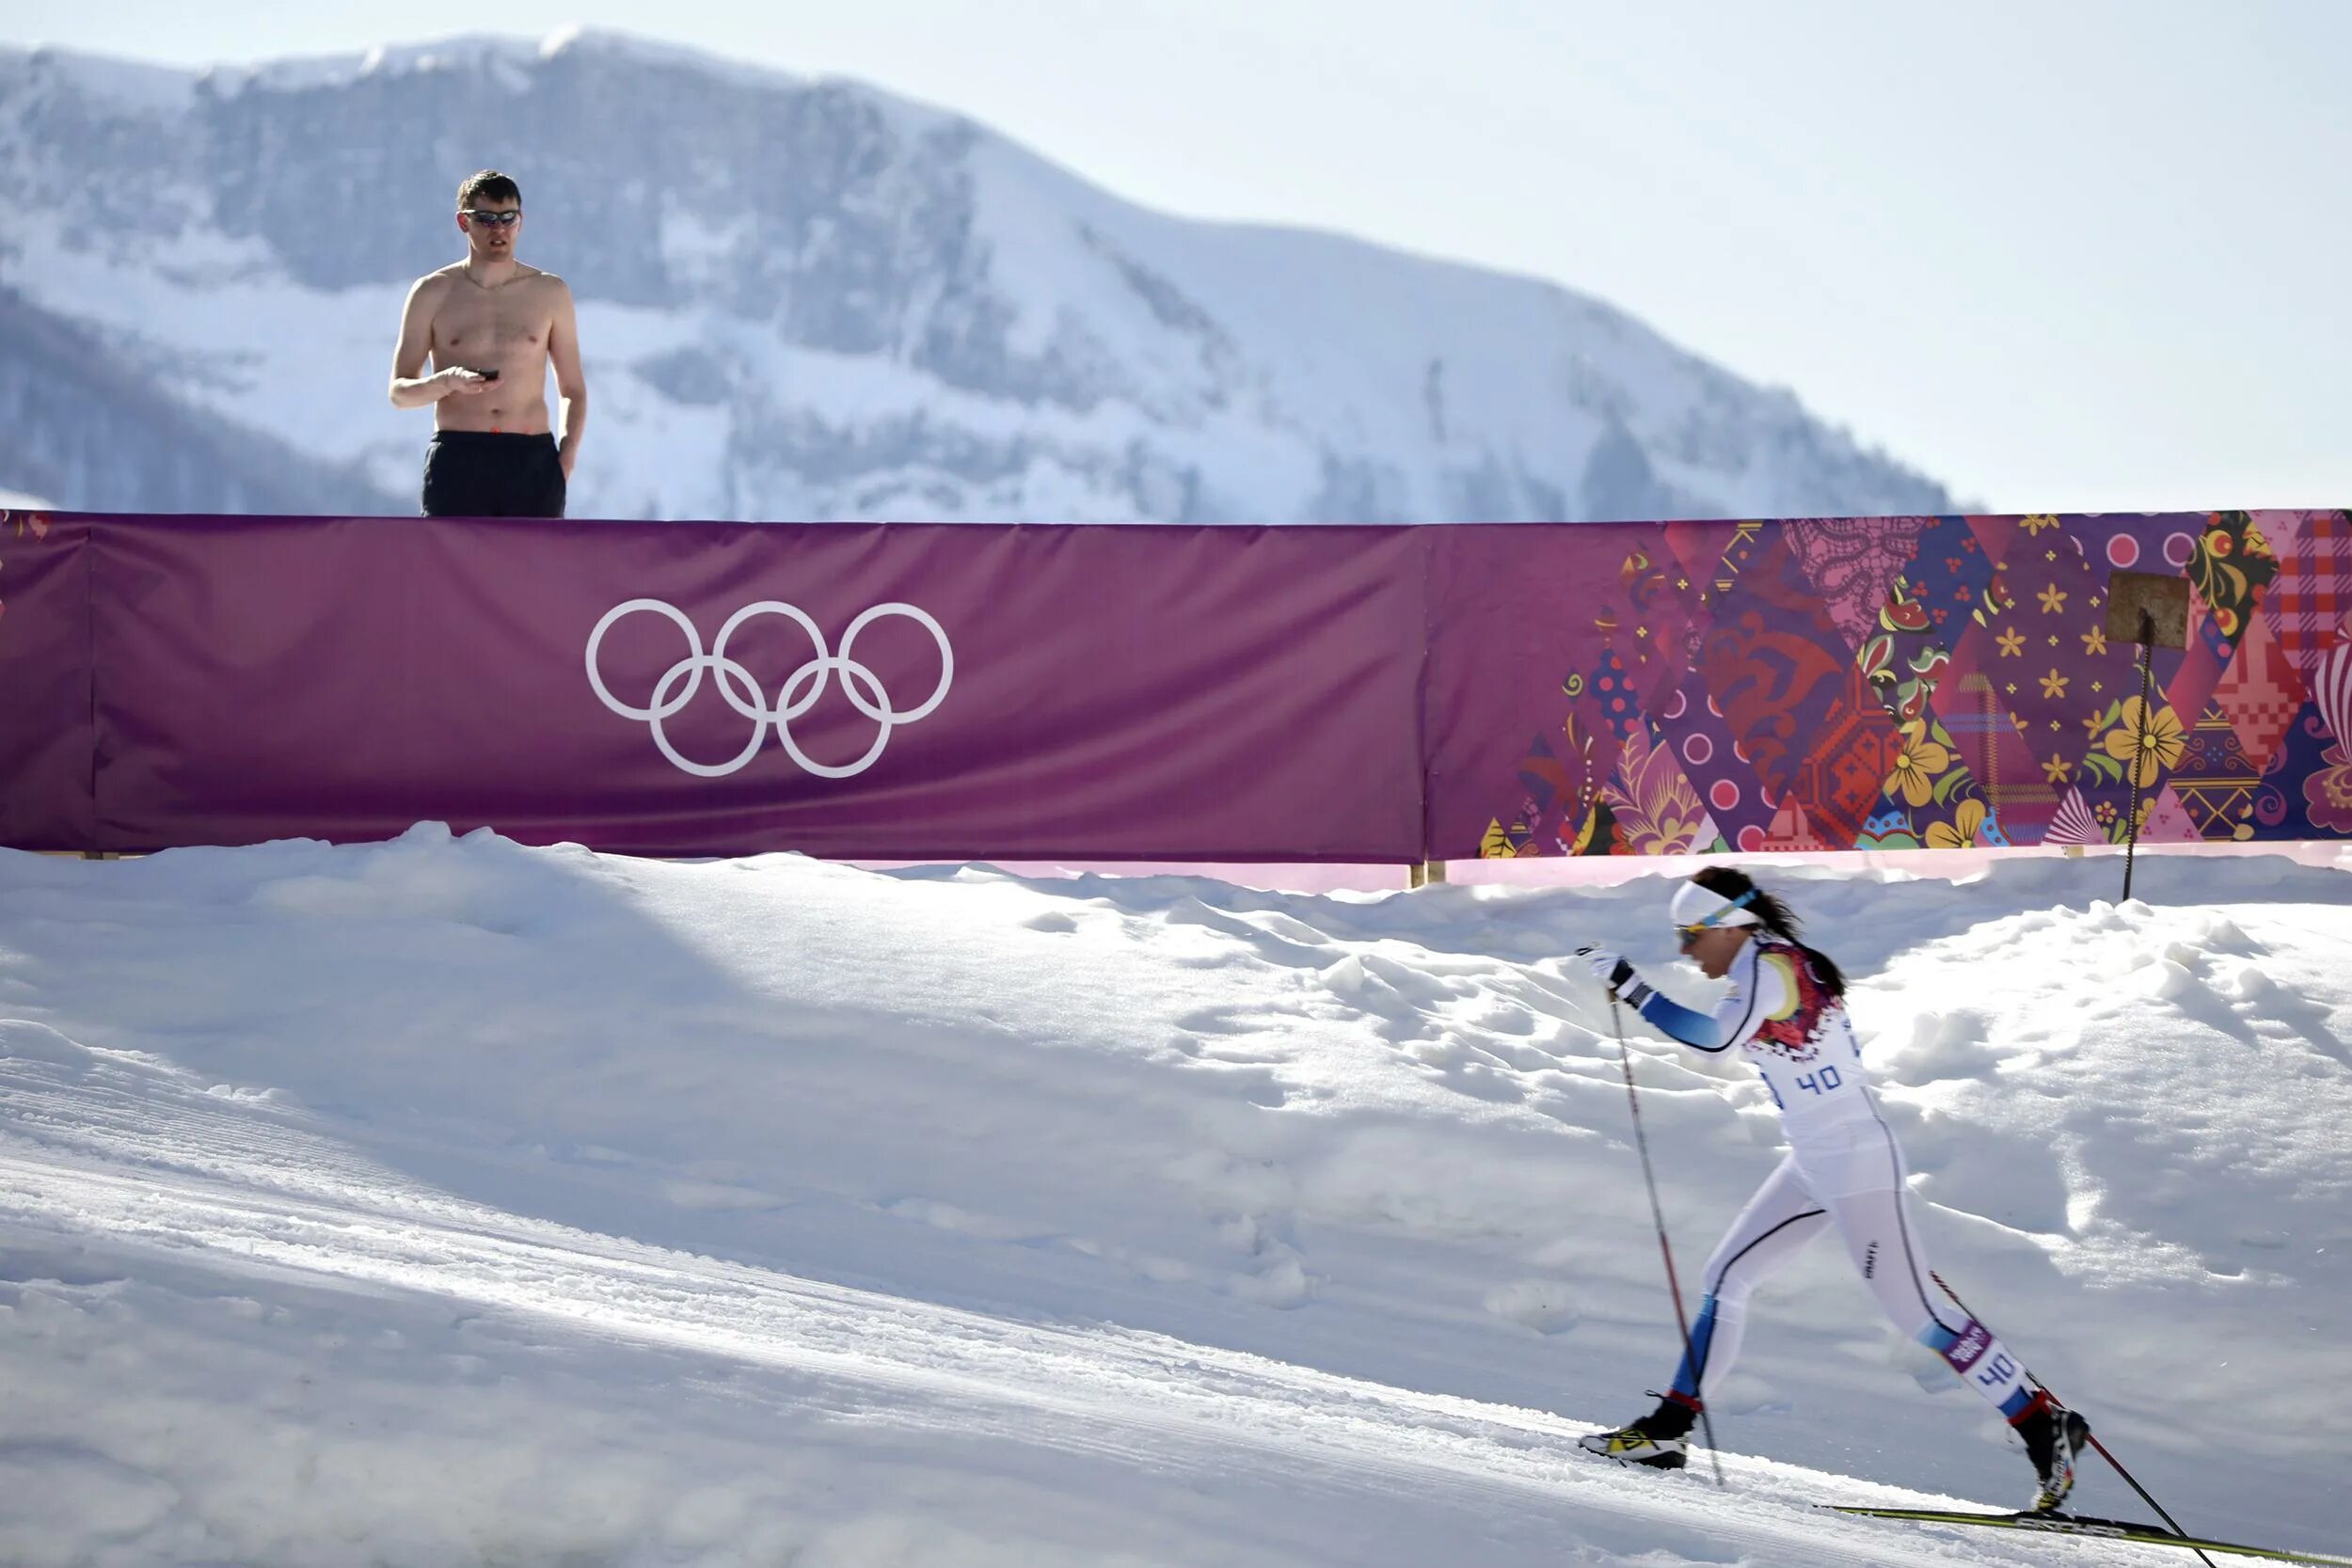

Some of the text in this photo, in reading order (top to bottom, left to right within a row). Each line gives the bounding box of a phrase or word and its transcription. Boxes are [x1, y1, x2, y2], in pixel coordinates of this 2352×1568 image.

[1795, 1065, 1841, 1095] 40
[1978, 1352, 2015, 1386] 40
[2016, 1517, 2126, 1537] FISCHER
